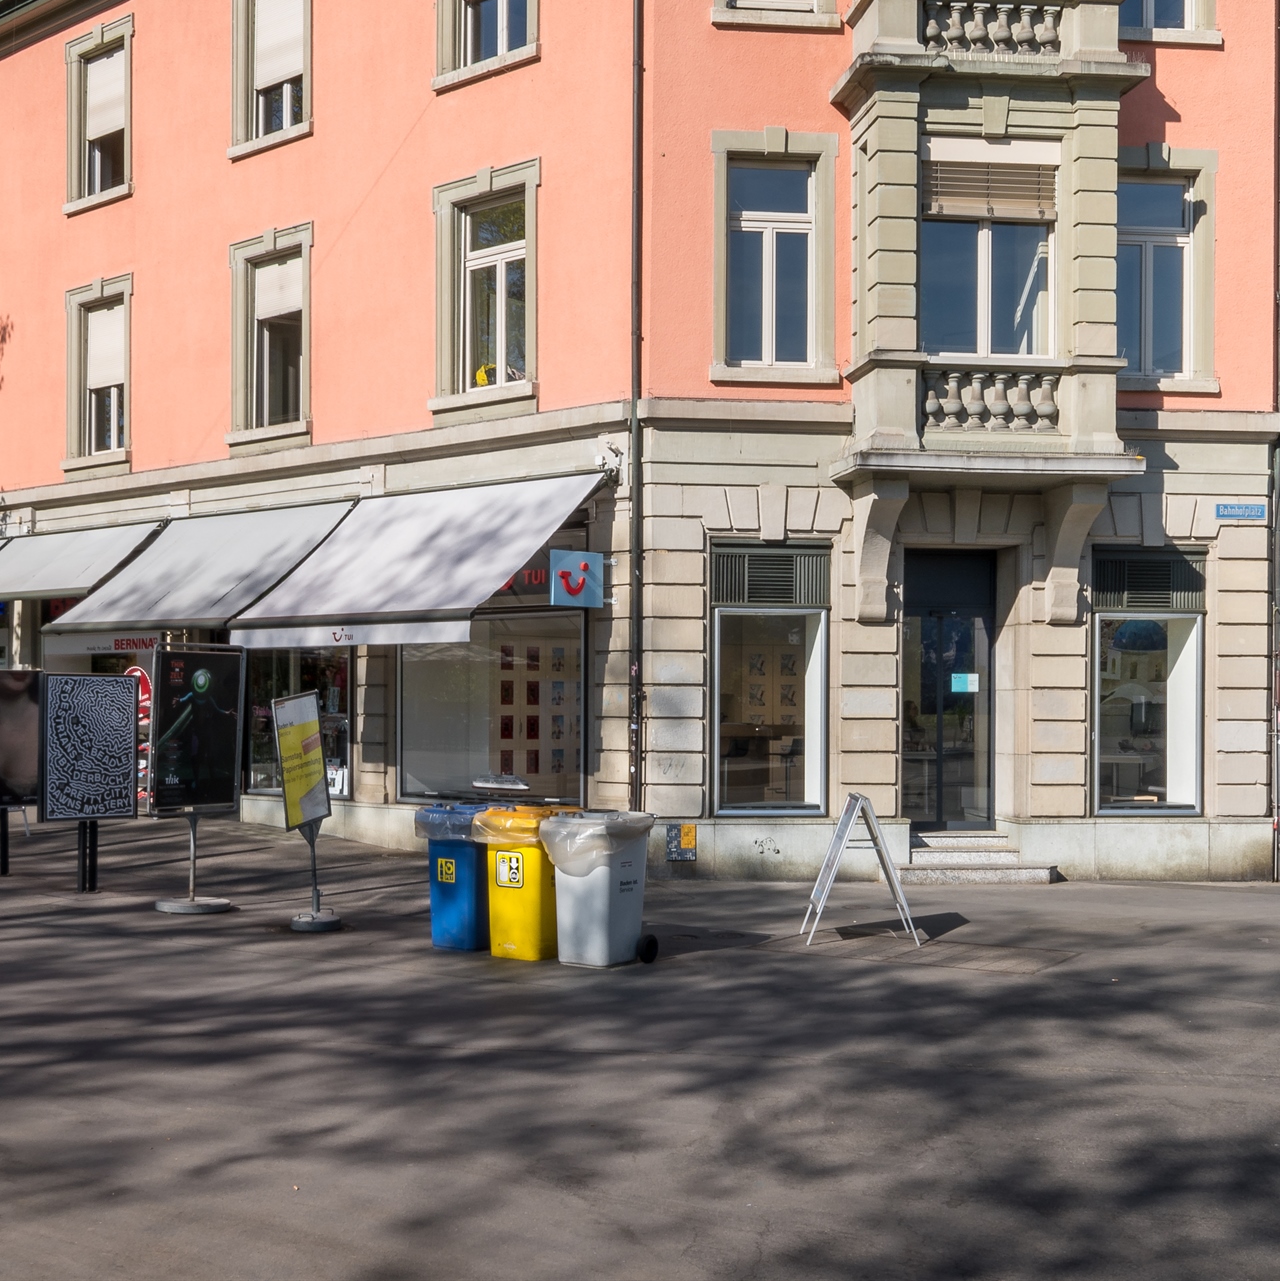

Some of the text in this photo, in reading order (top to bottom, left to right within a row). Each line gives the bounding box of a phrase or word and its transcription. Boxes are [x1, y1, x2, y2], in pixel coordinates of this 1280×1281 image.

[1219, 505, 1262, 518] Bahnhofplatz
[523, 570, 545, 585] TUI
[114, 638, 154, 651] BERNINA
[55, 679, 78, 759] PEDESTRIANS
[73, 723, 91, 748] JEFF
[281, 752, 303, 764] Samstag
[282, 757, 322, 775] Papiersammlung
[59, 758, 124, 785] BILDERBUCH
[48, 783, 130, 815] DAWNS MYSTERY
[63, 785, 129, 804] PRETTY CITY
[619, 886, 634, 894] Service
